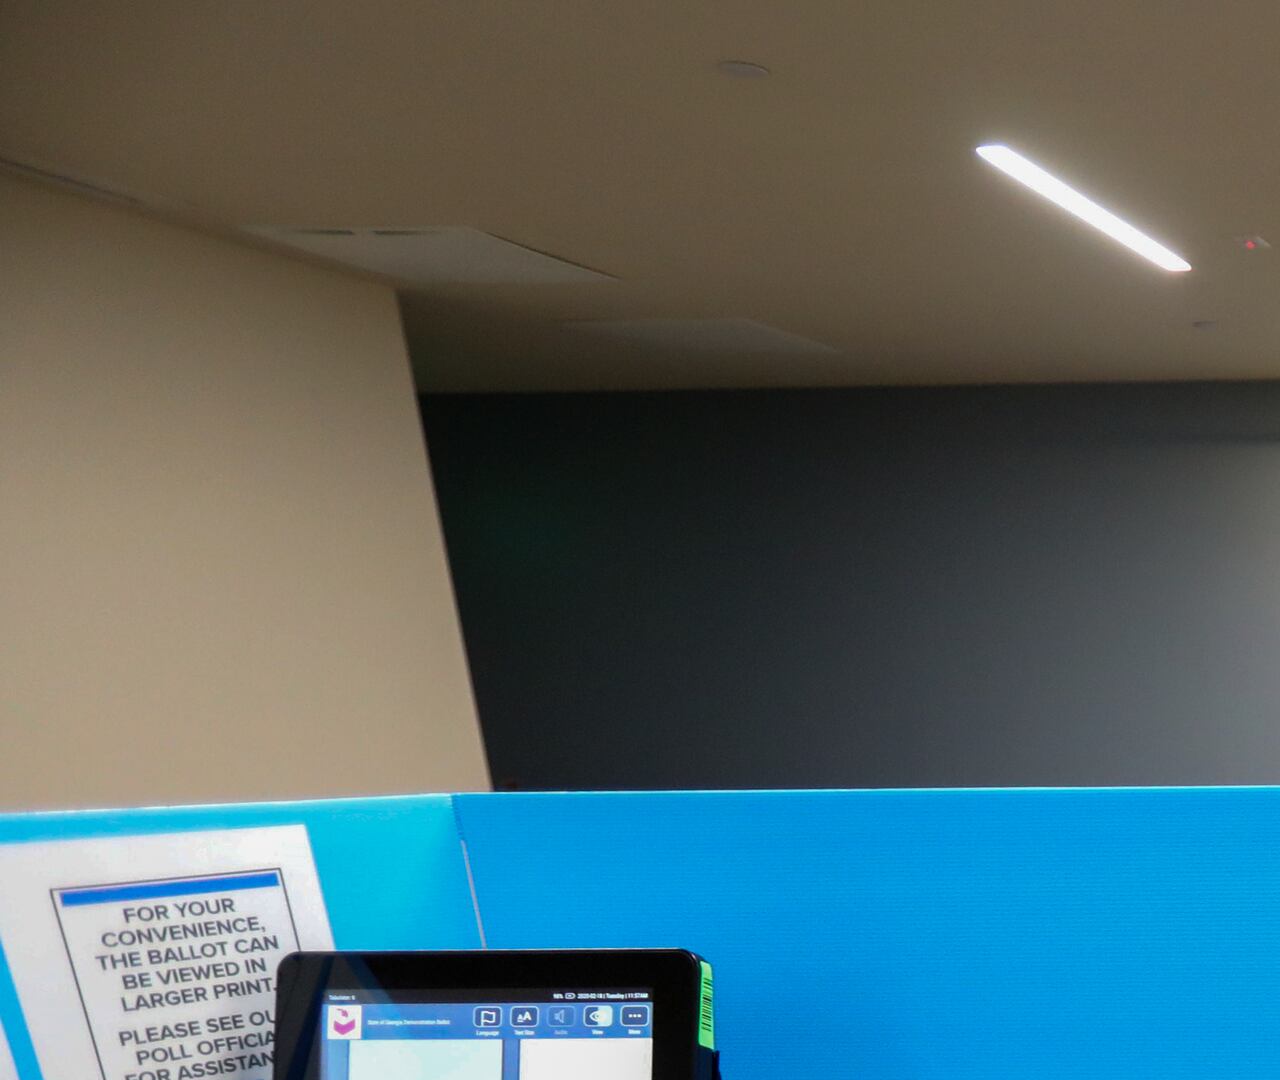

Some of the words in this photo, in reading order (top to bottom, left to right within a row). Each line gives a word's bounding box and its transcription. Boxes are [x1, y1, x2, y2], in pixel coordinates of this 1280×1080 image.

[123, 905, 168, 923] FOR
[175, 898, 236, 917] YOUR
[101, 917, 266, 948] CONVENIENCE,
[95, 952, 142, 971] THE
[147, 941, 228, 965] BALLOT
[234, 935, 279, 954] CAN
[122, 972, 152, 990] BE
[156, 962, 240, 985] VIEWED
[244, 958, 267, 974] IN
[121, 987, 208, 1012] LARGER
[213, 978, 277, 1000] PRINT.
[118, 1021, 201, 1046] PLEASE
[206, 1014, 245, 1033] SEE
[249, 1010, 276, 1026] OU
[136, 1045, 192, 1066] POLL
[197, 1030, 276, 1055] OFFICIA
[178, 1051, 275, 1080] ASSISTAN
